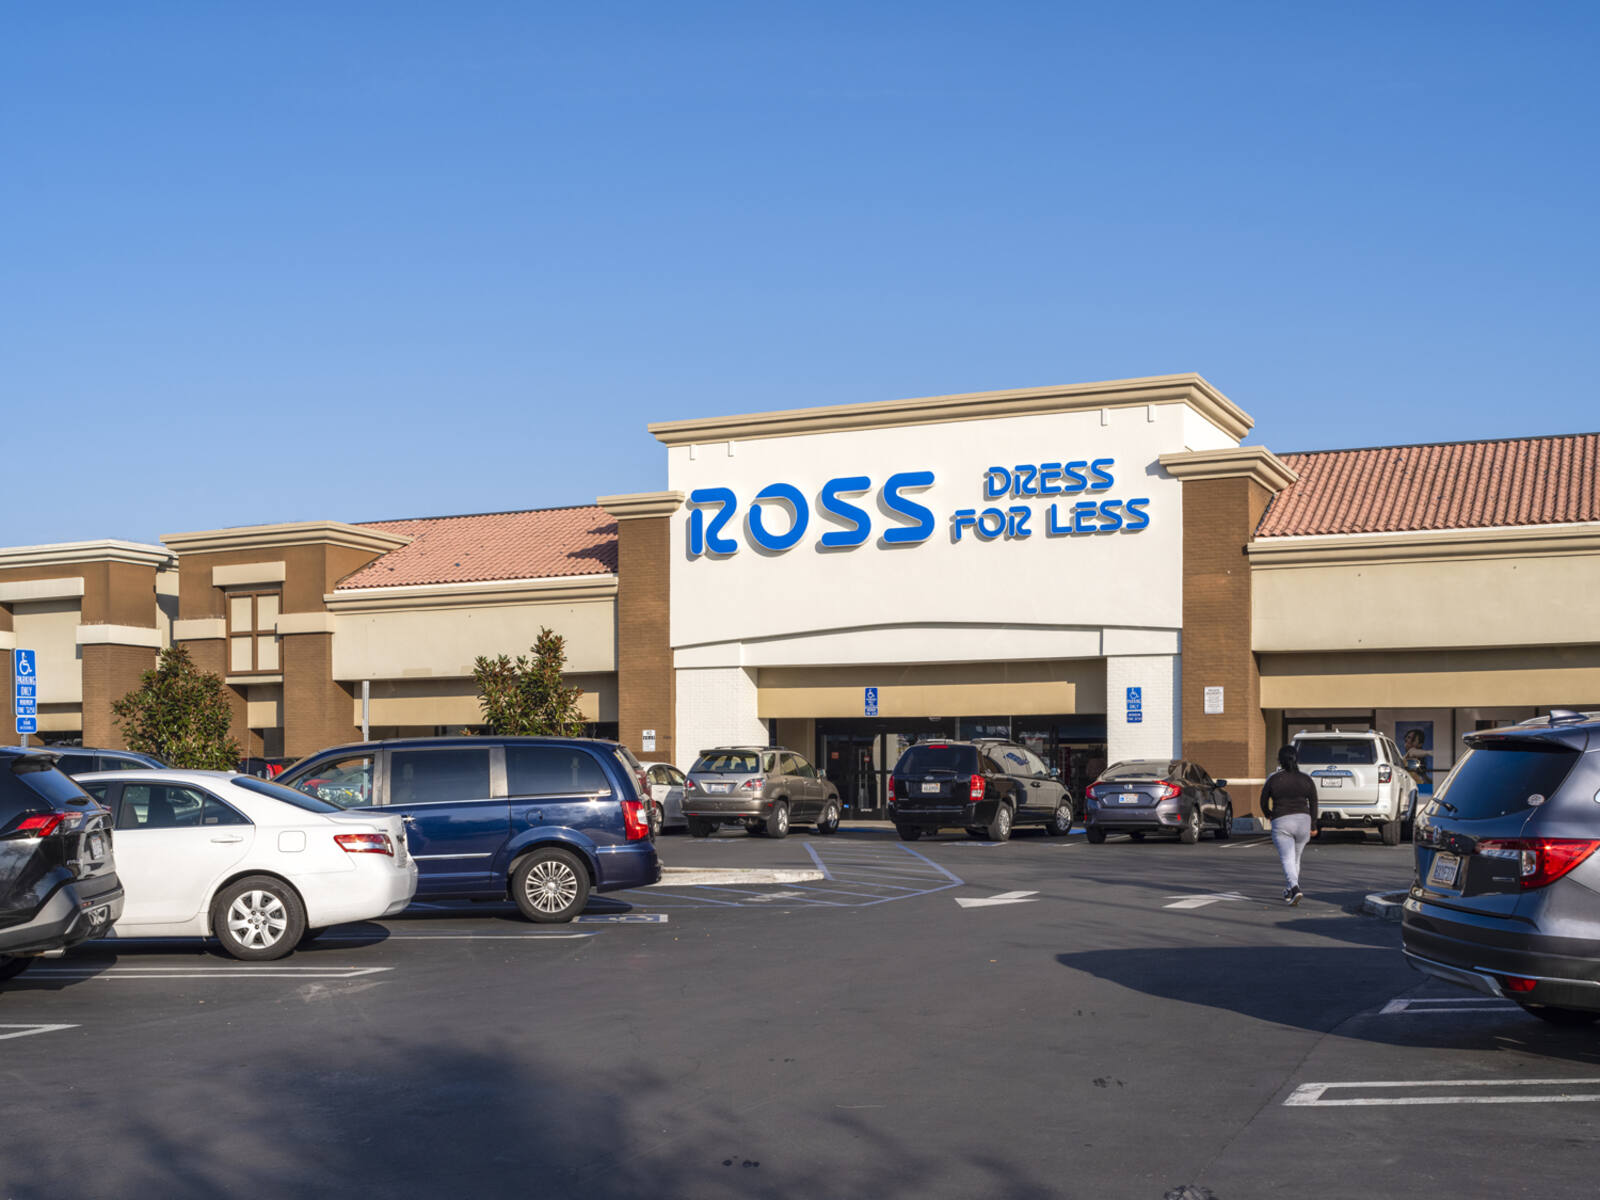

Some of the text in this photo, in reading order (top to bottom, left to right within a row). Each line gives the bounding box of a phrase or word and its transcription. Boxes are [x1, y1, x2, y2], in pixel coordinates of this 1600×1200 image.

[987, 458, 1115, 498] DRESS
[690, 470, 935, 555] ROSS
[954, 497, 1150, 541] FOR LESS
